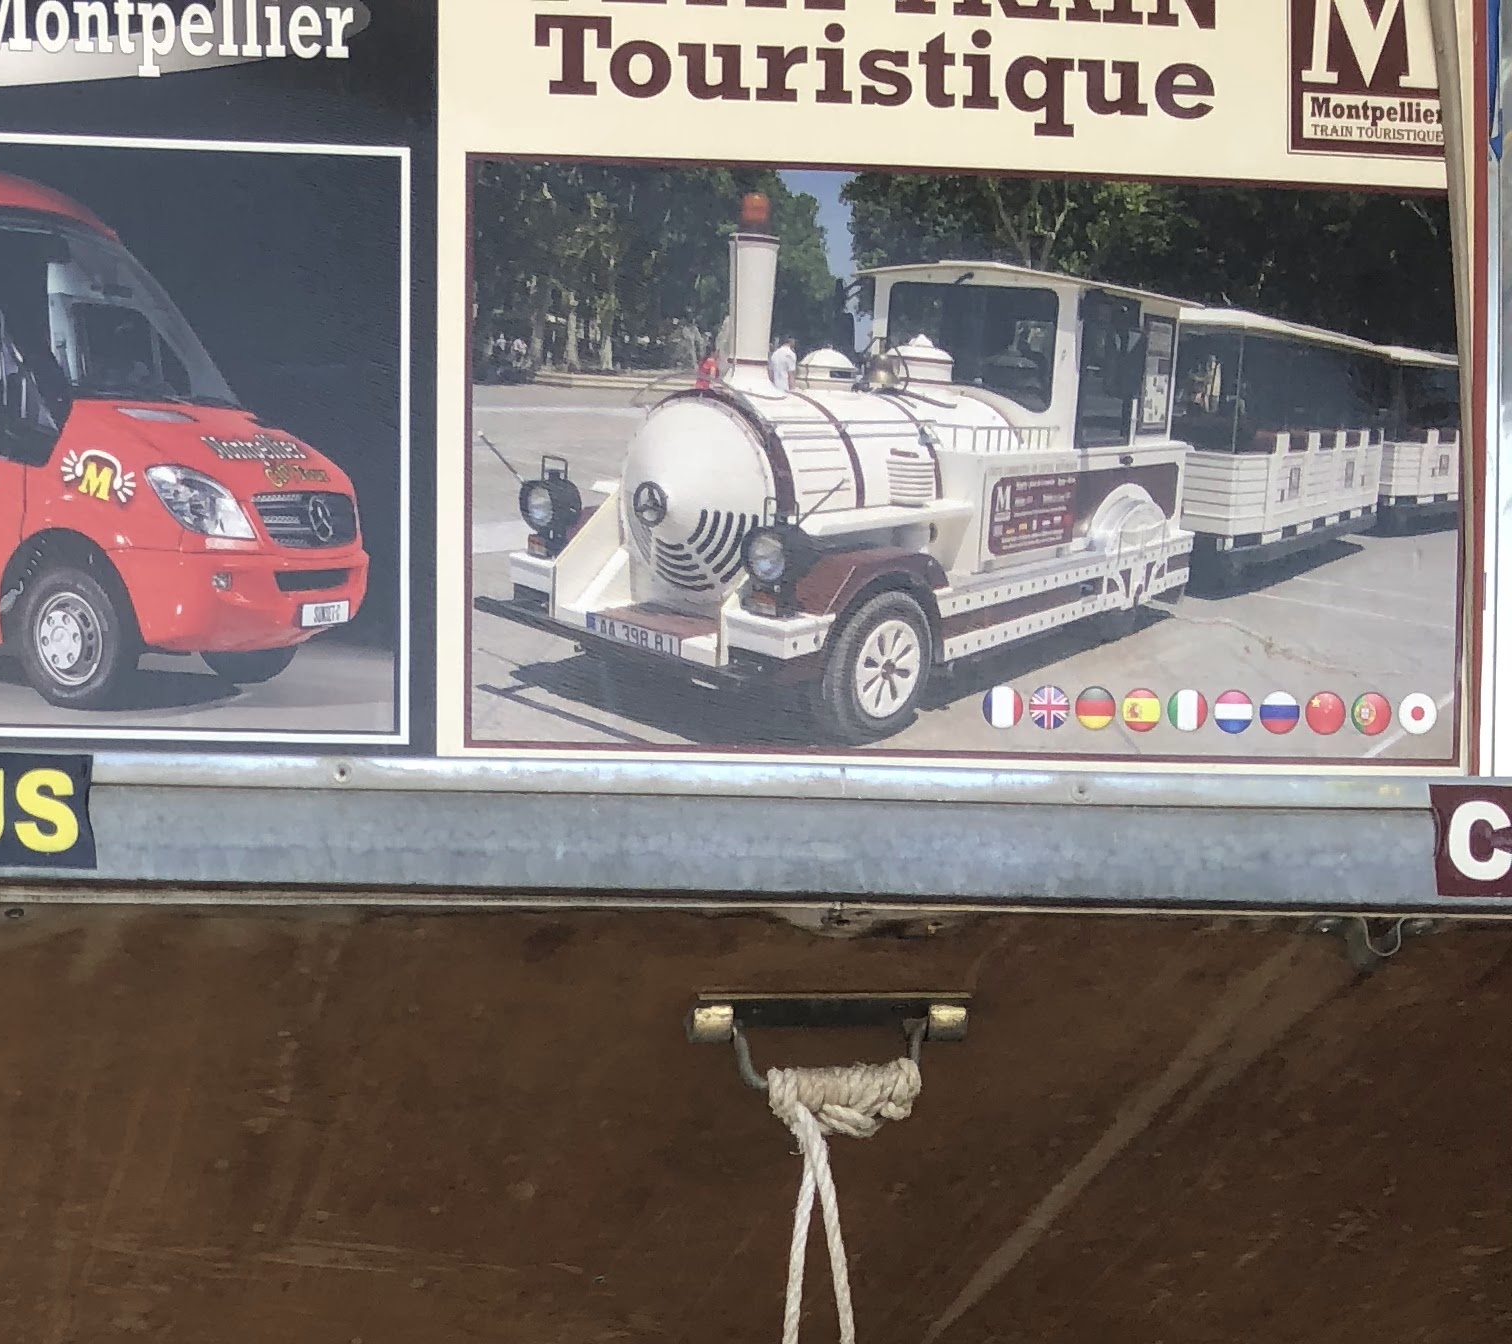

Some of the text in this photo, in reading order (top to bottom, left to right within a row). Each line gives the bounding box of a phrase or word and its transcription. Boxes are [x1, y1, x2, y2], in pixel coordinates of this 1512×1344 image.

[534, 12, 1216, 138] Touristique
[1311, 123, 1445, 143] TRAIN TOURISTIQUE
